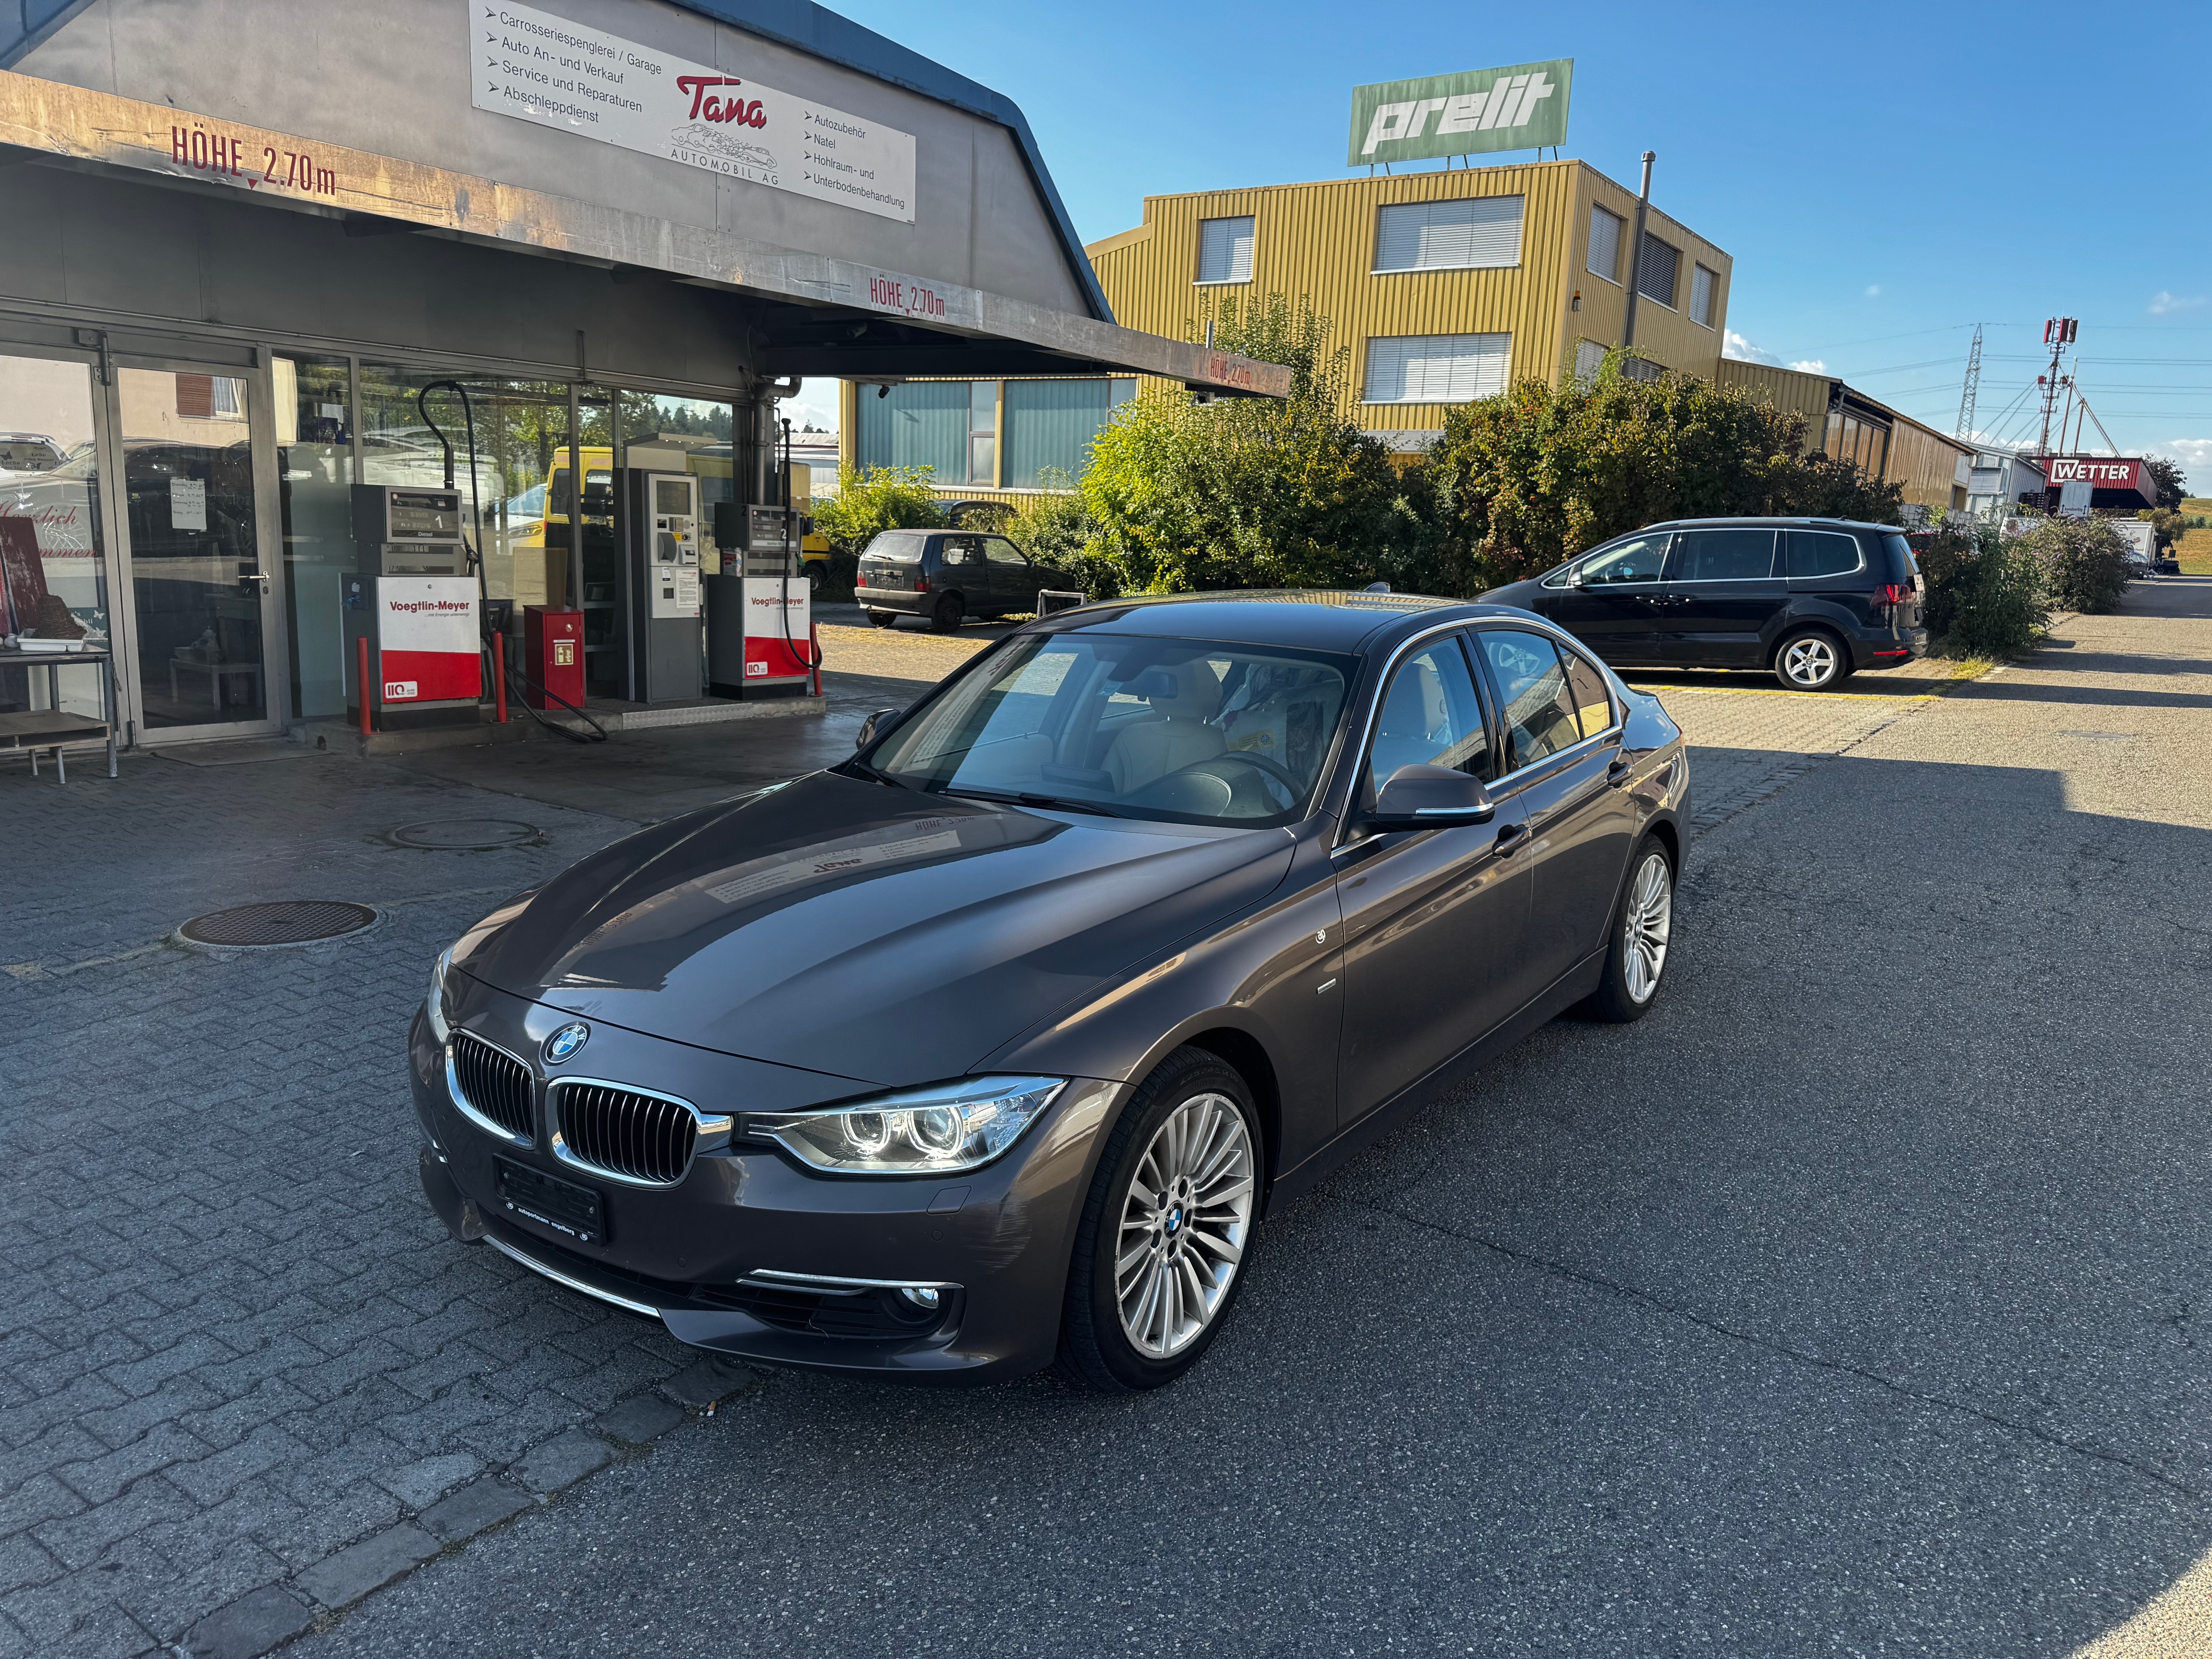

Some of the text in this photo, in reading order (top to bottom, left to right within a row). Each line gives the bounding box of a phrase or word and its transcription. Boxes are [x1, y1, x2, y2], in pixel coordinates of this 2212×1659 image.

[500, 12, 661, 74] Carrosseriespenglerei / Garage
[502, 36, 623, 84] Auto An- und Verkauf
[503, 60, 642, 112] Service und Reparaturen
[504, 86, 598, 123] Abschleppdienst
[677, 76, 767, 129] Tana
[1361, 72, 1555, 155] prelit
[814, 114, 866, 139] Autozubehör
[814, 133, 835, 149] Natel
[172, 122, 242, 177] HÖHE
[671, 148, 778, 185] AUTOMOBIL AG
[814, 153, 874, 179] Hohlraum- und
[814, 173, 905, 210] Unterbodenbehandlung
[870, 273, 903, 308] HÖHE
[2057, 464, 2130, 480] WETTER
[435, 515, 443, 528] 1
[742, 505, 747, 516] 2
[780, 528, 787, 539] 2
[390, 601, 470, 613] Voegtlin-Meyer
[751, 597, 804, 607] Voegtlin-eyer
[518, 1207, 550, 1224] autoportmann
[551, 1221, 575, 1236] engelberg
